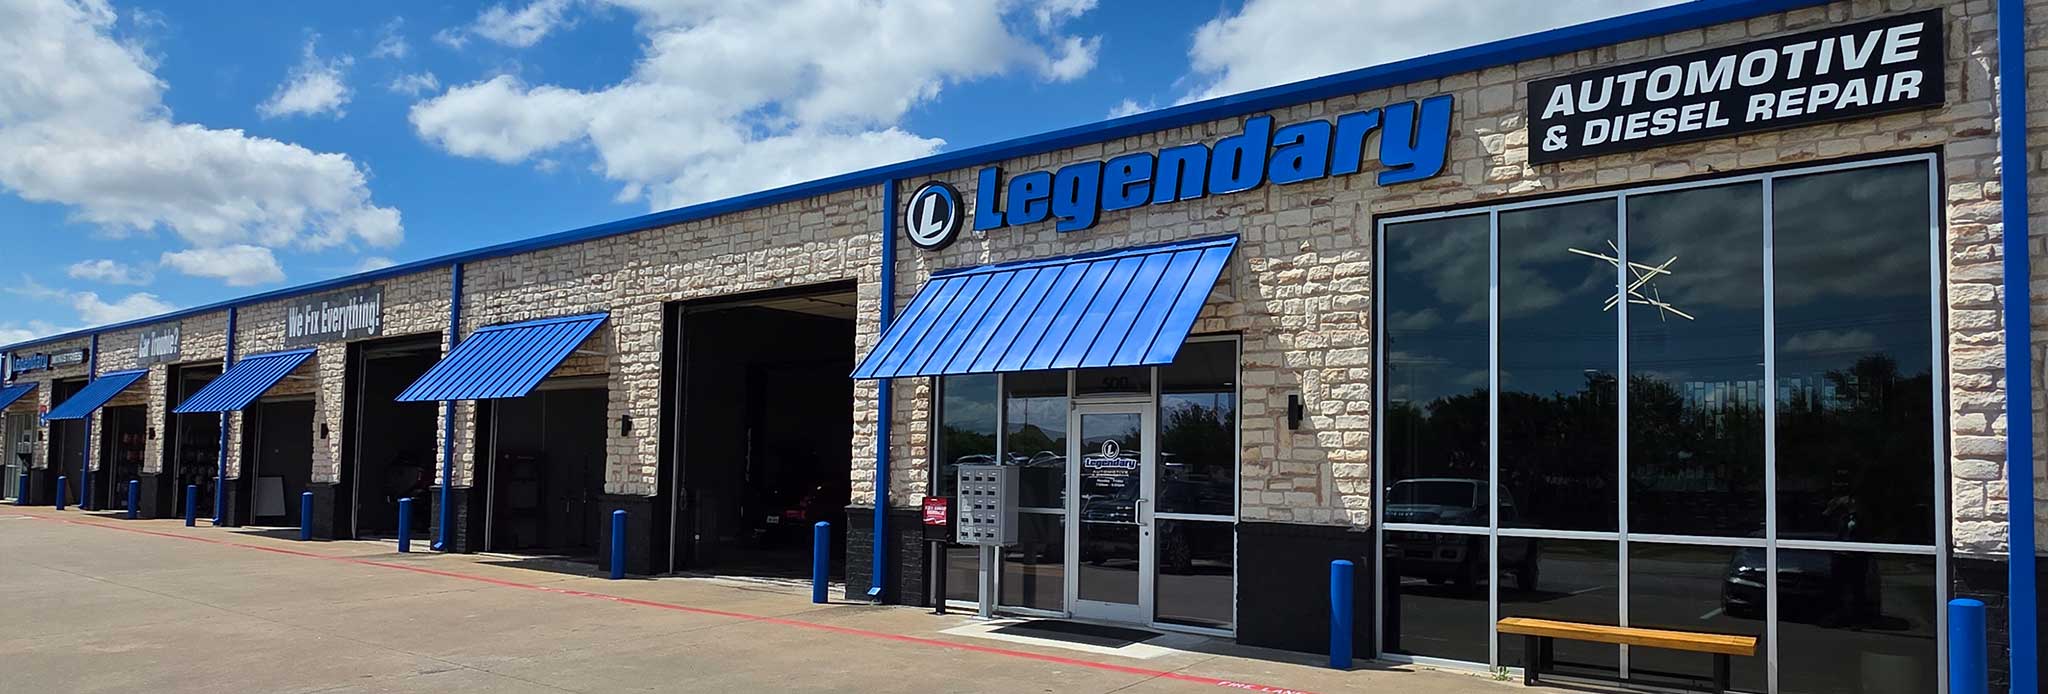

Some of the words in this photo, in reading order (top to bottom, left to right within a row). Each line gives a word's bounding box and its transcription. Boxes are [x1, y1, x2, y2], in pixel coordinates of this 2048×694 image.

[1541, 22, 1924, 120] AUTOMOTIVE
[1542, 125, 1568, 152] &
[1581, 101, 1729, 146] DIESEL
[1745, 70, 1923, 123] REPAIR
[974, 94, 1454, 233] Legendary
[288, 306, 304, 338] We
[304, 304, 320, 335] Fix
[321, 292, 380, 338] Everything!
[1085, 457, 1136, 469] Legendary
